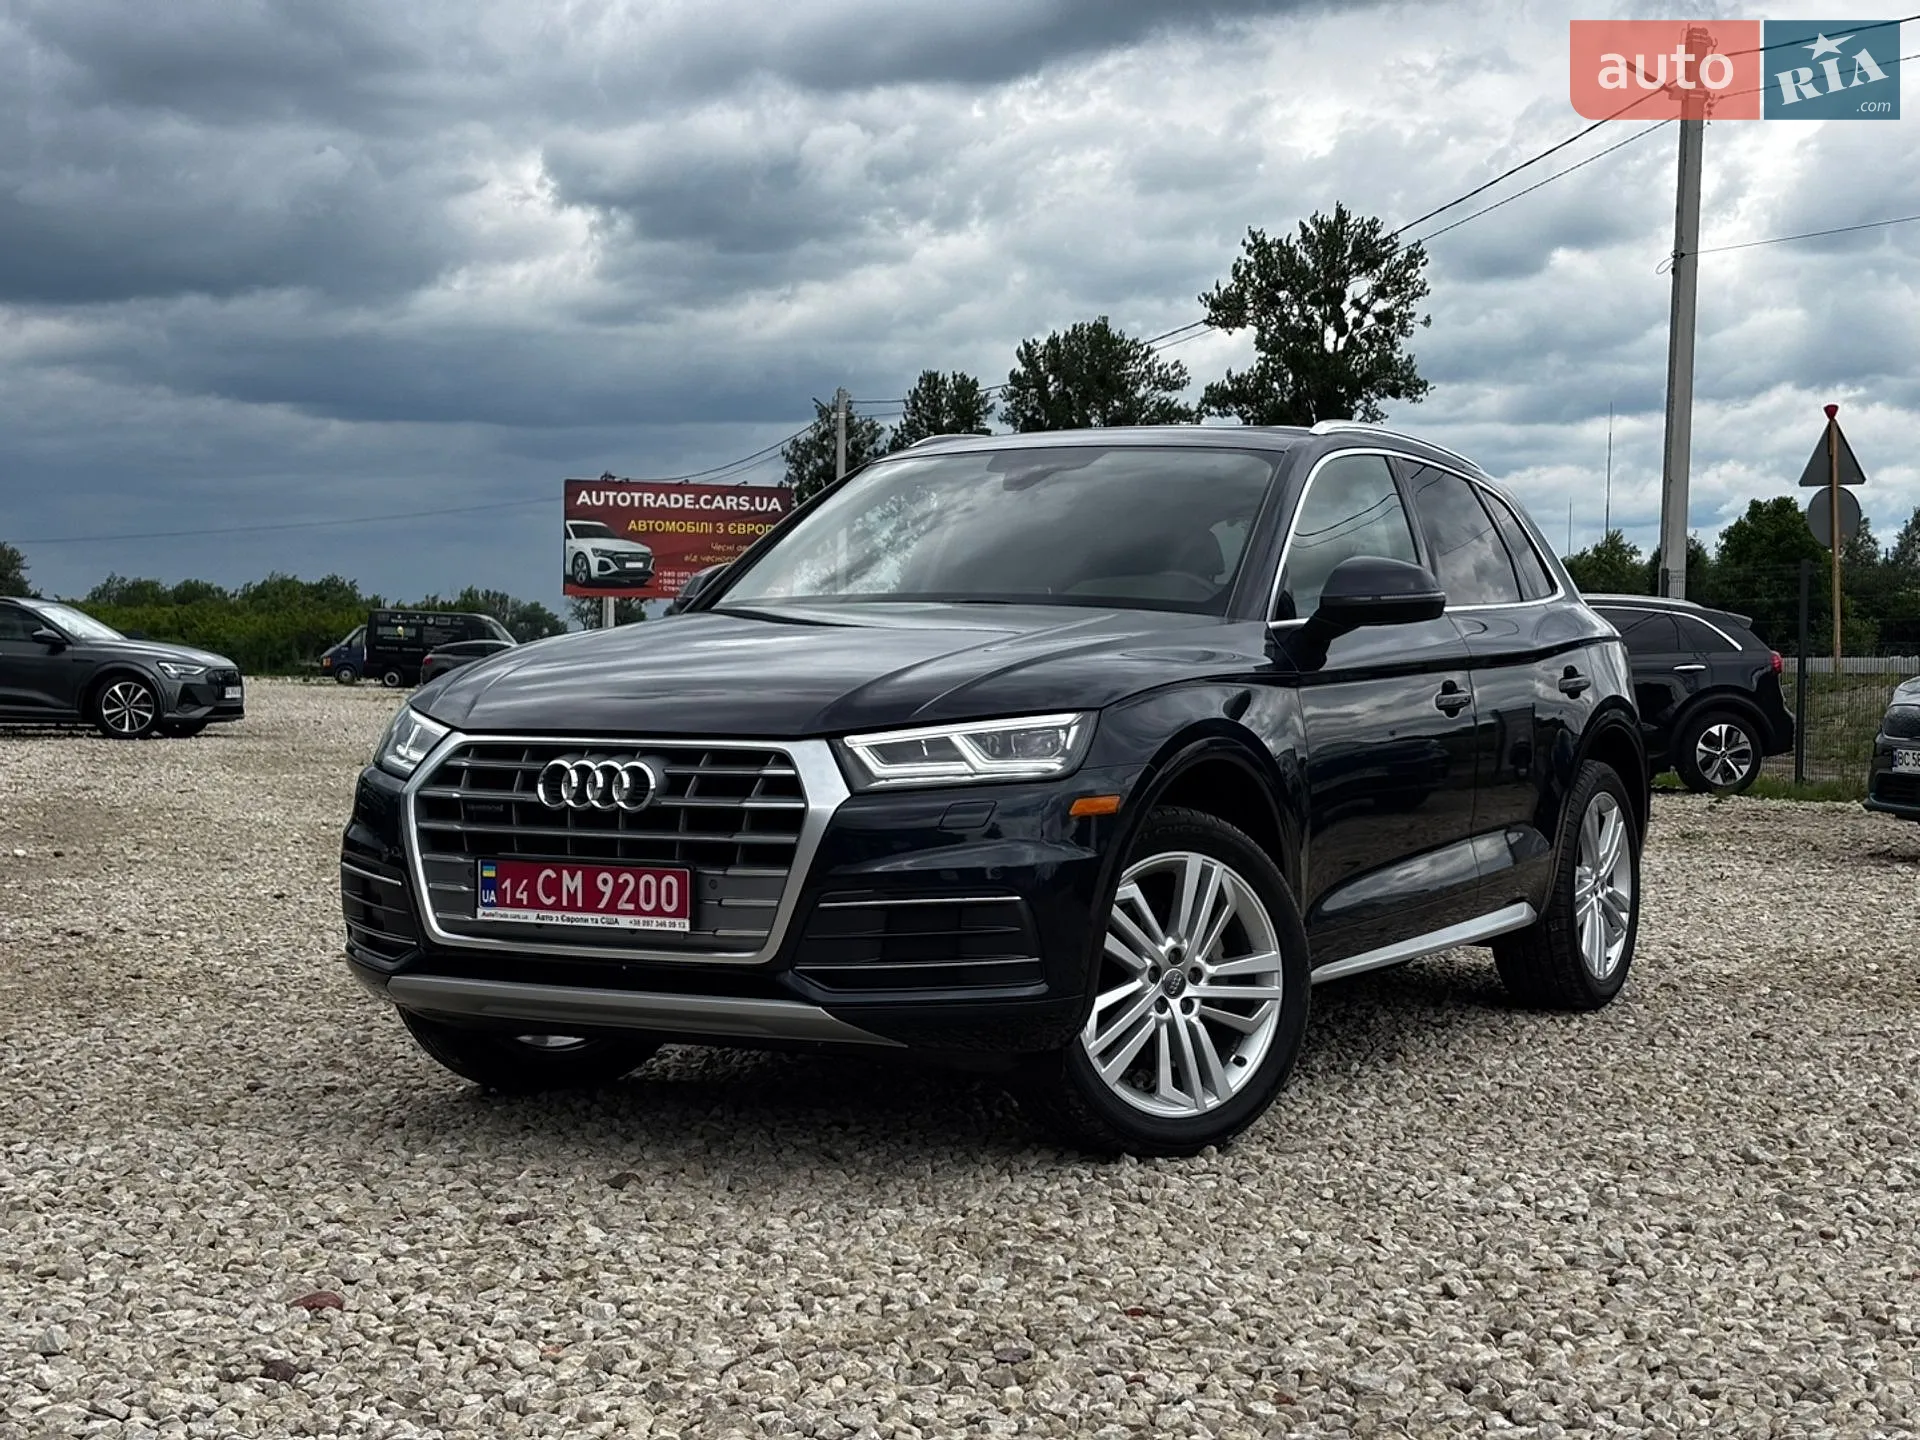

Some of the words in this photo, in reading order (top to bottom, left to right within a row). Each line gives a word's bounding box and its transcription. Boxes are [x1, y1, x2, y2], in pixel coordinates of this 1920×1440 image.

[576, 490, 782, 513] AUTOTRADE.CARS.UA
[628, 519, 712, 534] АВТОМОБІЛІ
[1897, 750, 1910, 766] BC
[482, 889, 497, 903] UA
[501, 877, 528, 905] 14
[536, 868, 583, 908] CM
[596, 871, 678, 913] 9200
[535, 913, 553, 922] Авто
[600, 916, 619, 926] США
